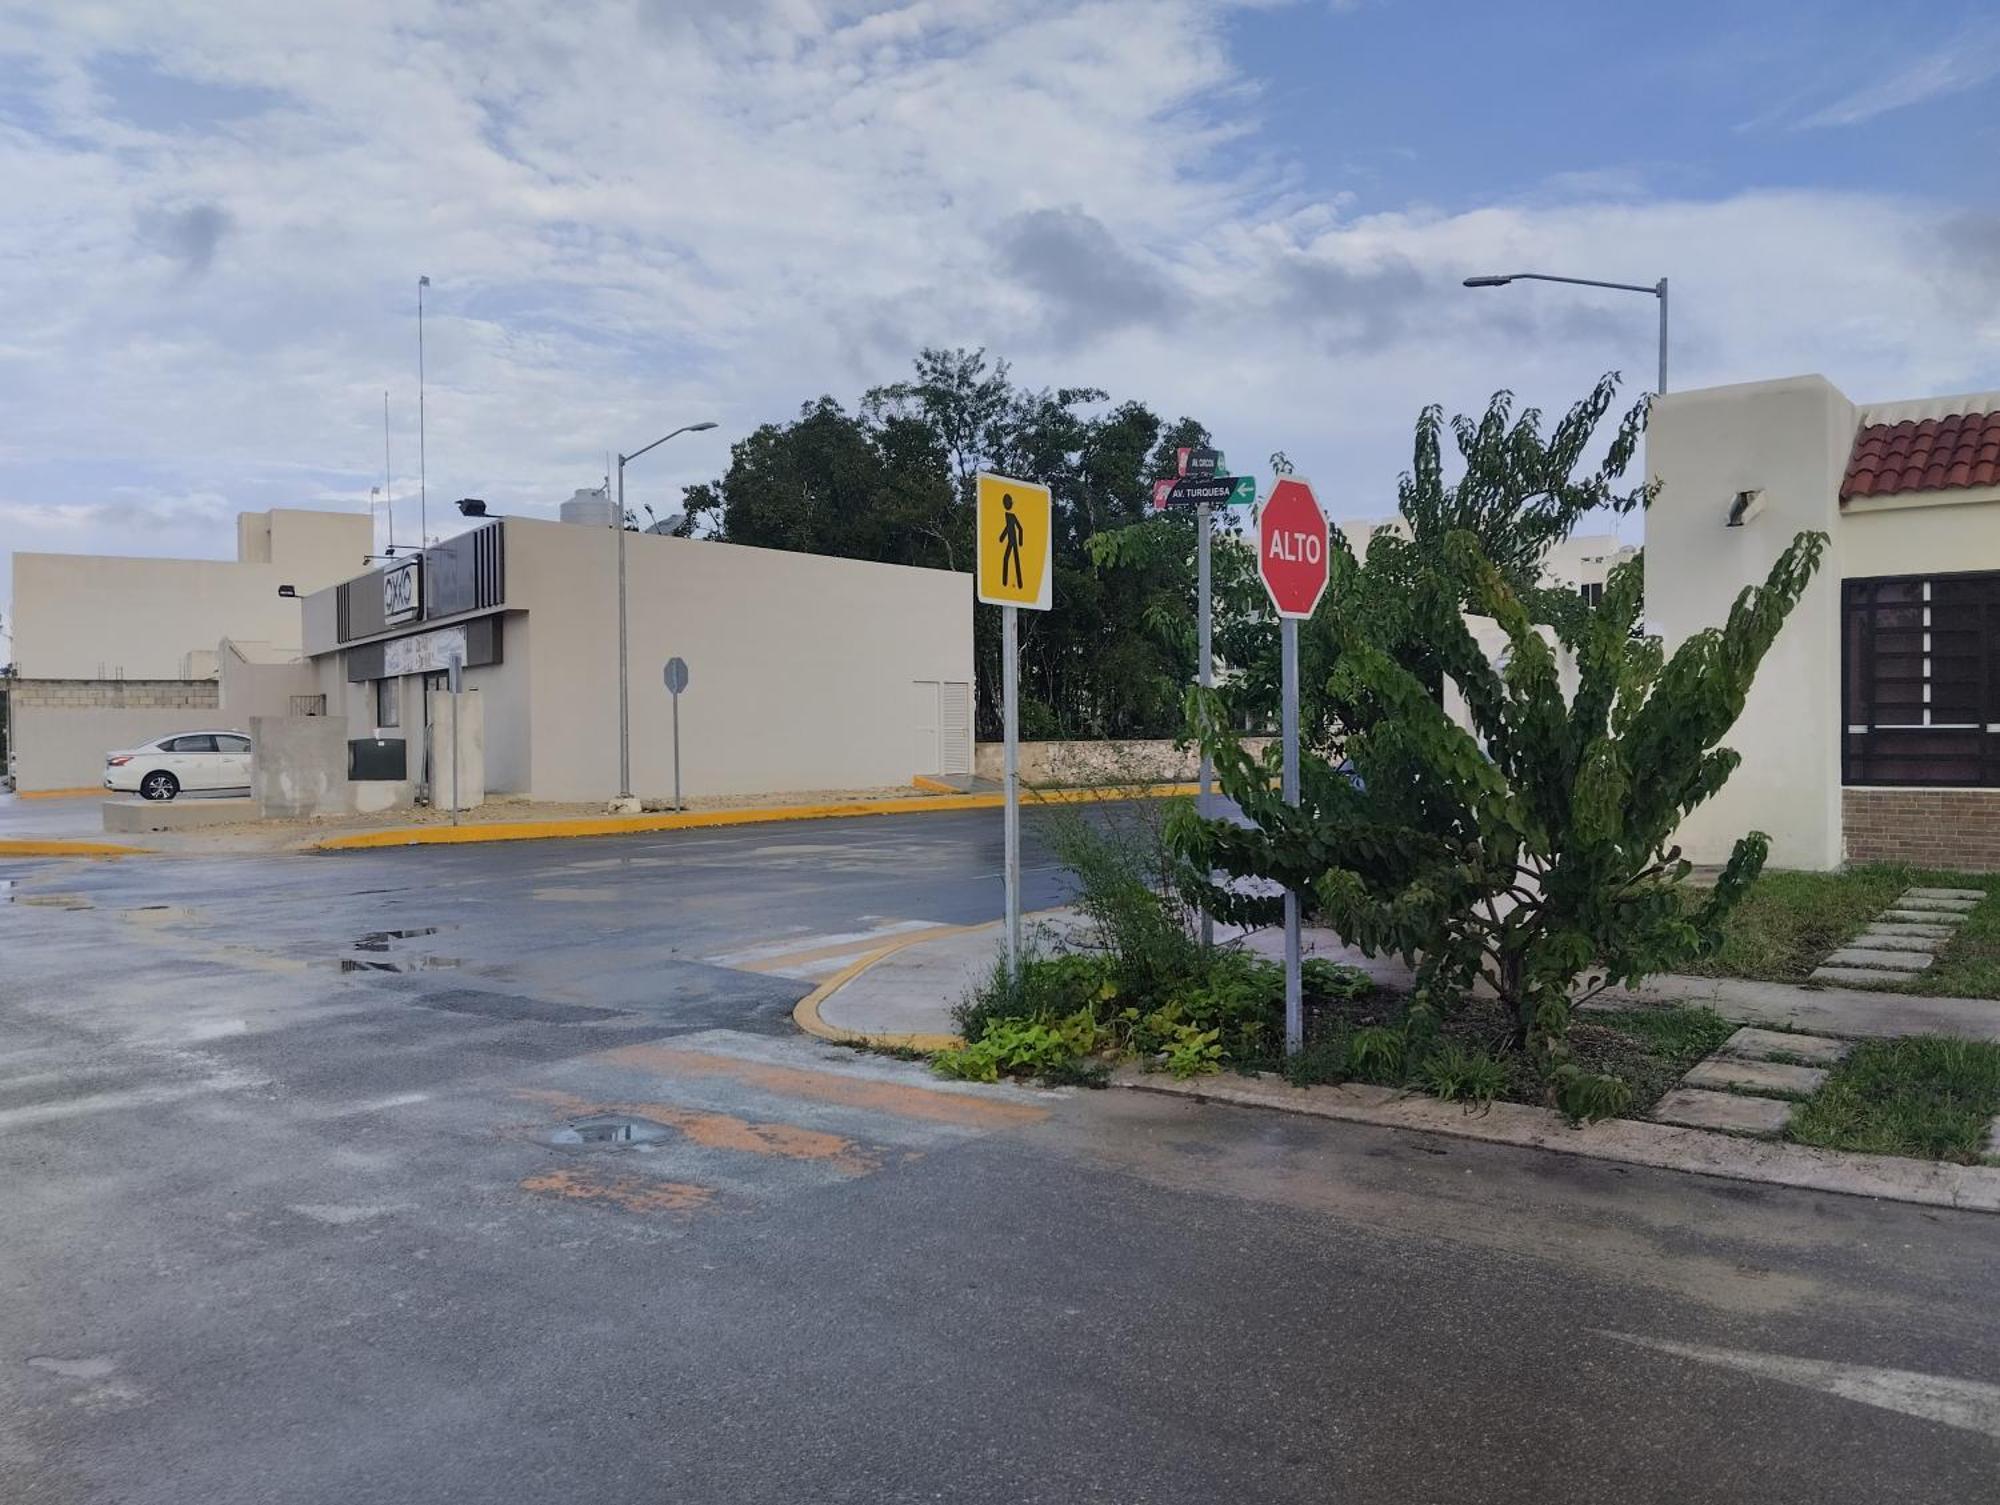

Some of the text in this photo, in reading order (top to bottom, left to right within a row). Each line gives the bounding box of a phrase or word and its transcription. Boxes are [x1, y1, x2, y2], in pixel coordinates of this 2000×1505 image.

[1172, 487, 1230, 498] AV. TURQUESA
[1269, 529, 1321, 564] ALTO
[384, 569, 412, 610] OXXO
